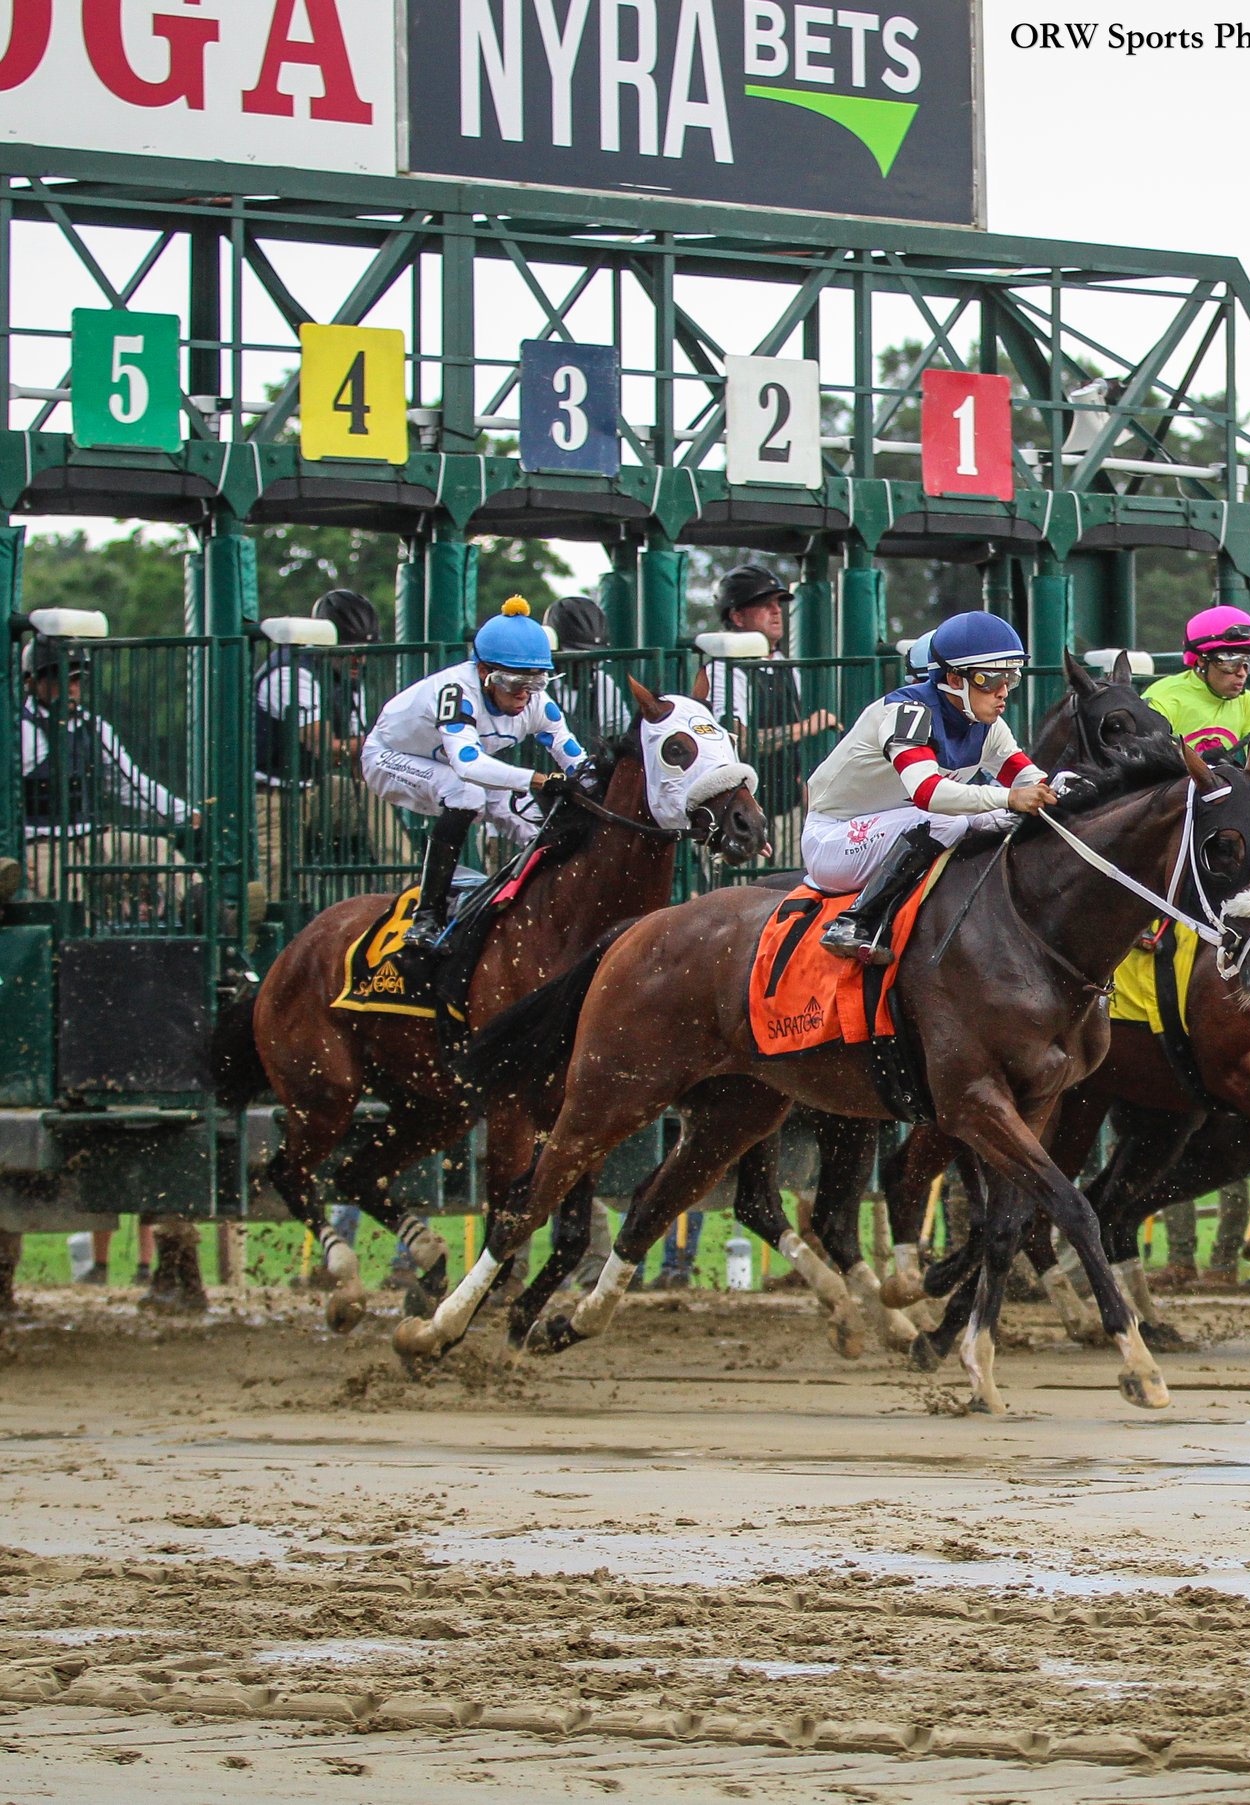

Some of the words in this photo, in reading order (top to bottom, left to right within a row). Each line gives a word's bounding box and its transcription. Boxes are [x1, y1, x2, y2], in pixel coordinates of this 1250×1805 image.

[461, 0, 733, 163] NYRA
[744, 1, 921, 93] BETS
[109, 335, 149, 424] 5
[332, 350, 371, 435] 4
[551, 365, 588, 451] 3
[759, 382, 792, 463] 2
[952, 395, 978, 476] 1
[439, 687, 457, 720] 6
[903, 705, 926, 739] 7
[844, 843, 867, 856] EDDIE
[366, 886, 421, 968] 6
[764, 897, 824, 999] 7
